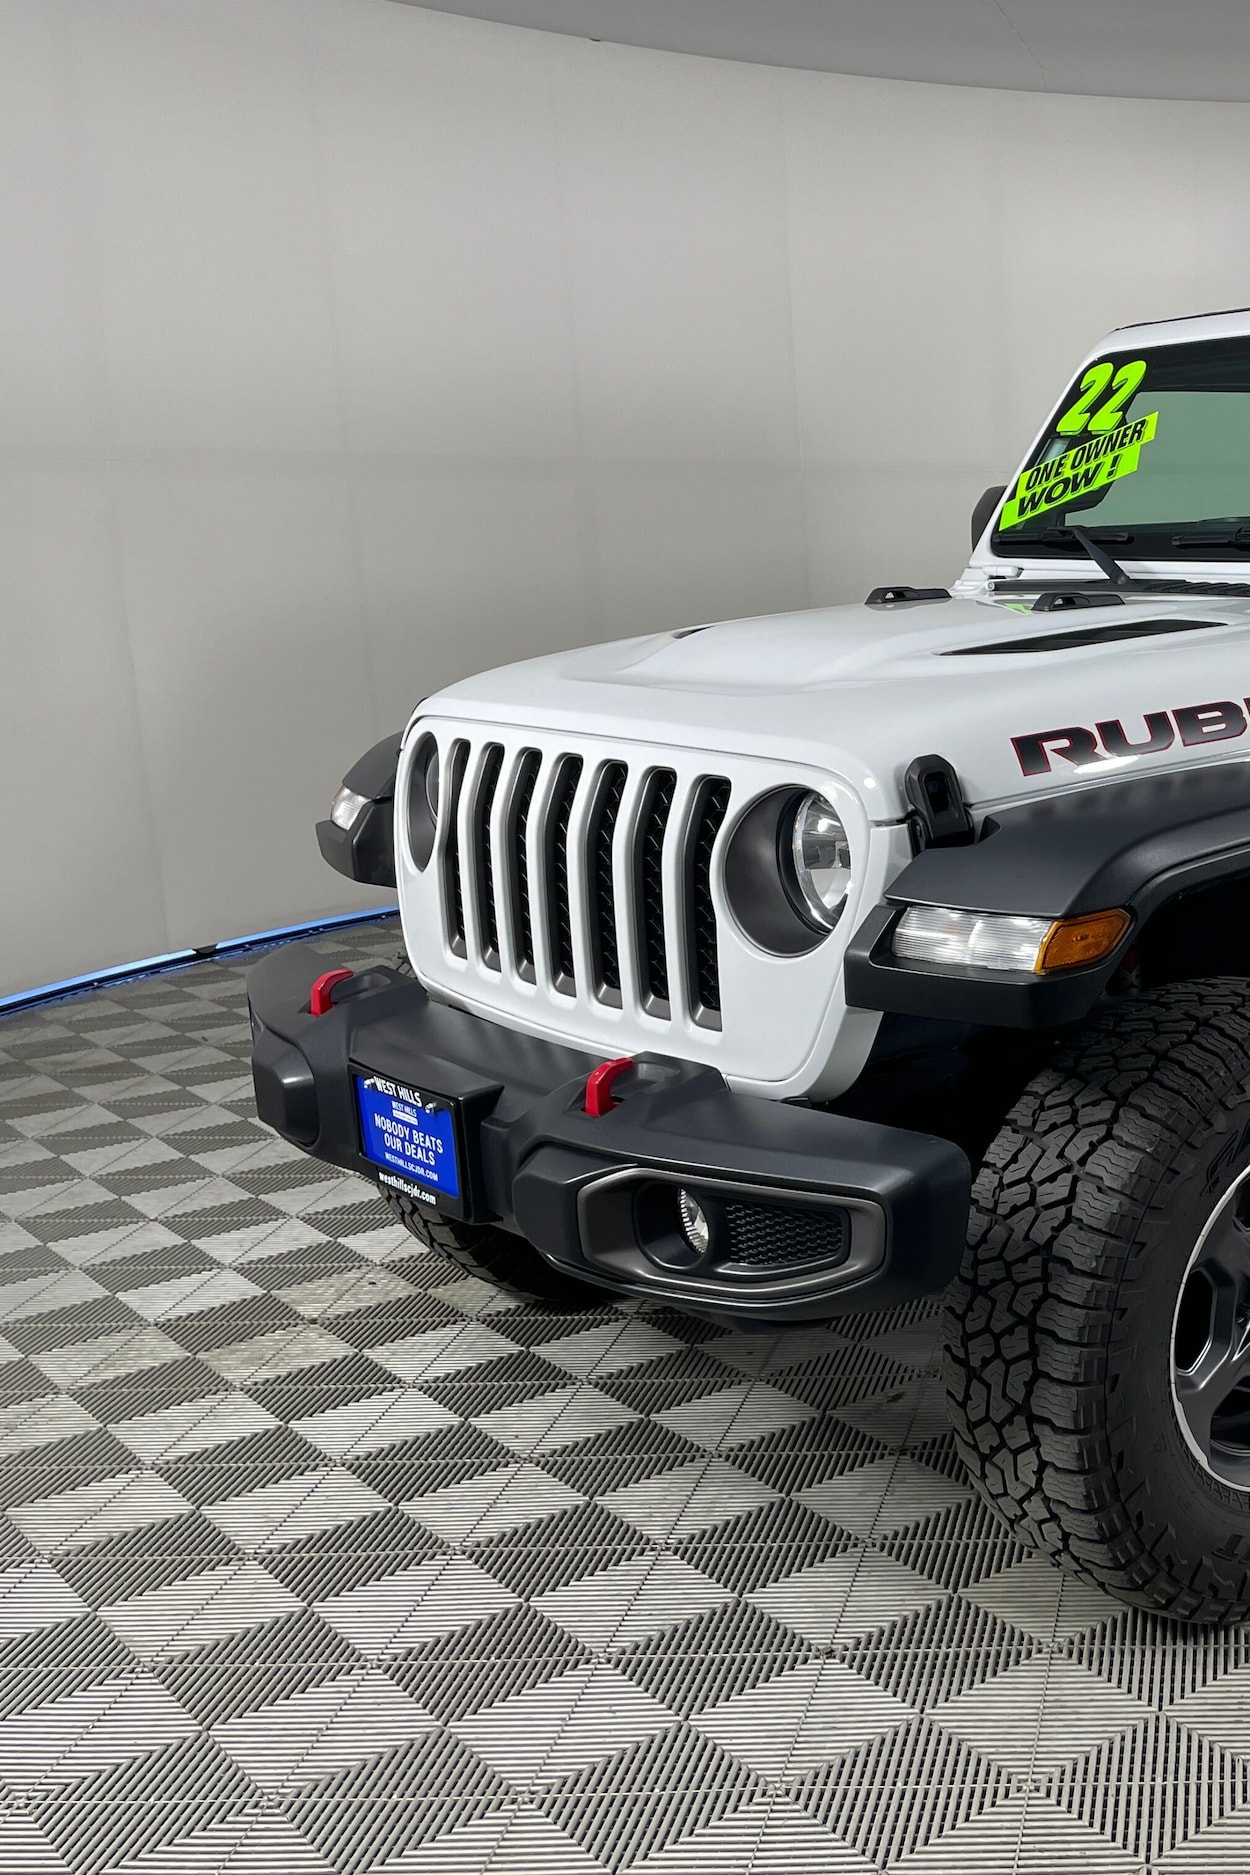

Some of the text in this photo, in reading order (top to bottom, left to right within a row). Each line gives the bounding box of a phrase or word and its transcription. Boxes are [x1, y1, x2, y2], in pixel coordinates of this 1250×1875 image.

[1056, 360, 1147, 436] 22
[1025, 418, 1148, 492] ONE OWNER
[374, 1076, 423, 1108] WEST HILLS
[391, 1100, 404, 1112] WEST
[374, 1113, 410, 1139] NOBODY
[412, 1128, 443, 1154] BEATS
[384, 1132, 436, 1166] OUR DEALS
[378, 1171, 437, 1206] westhillscjdr.com
